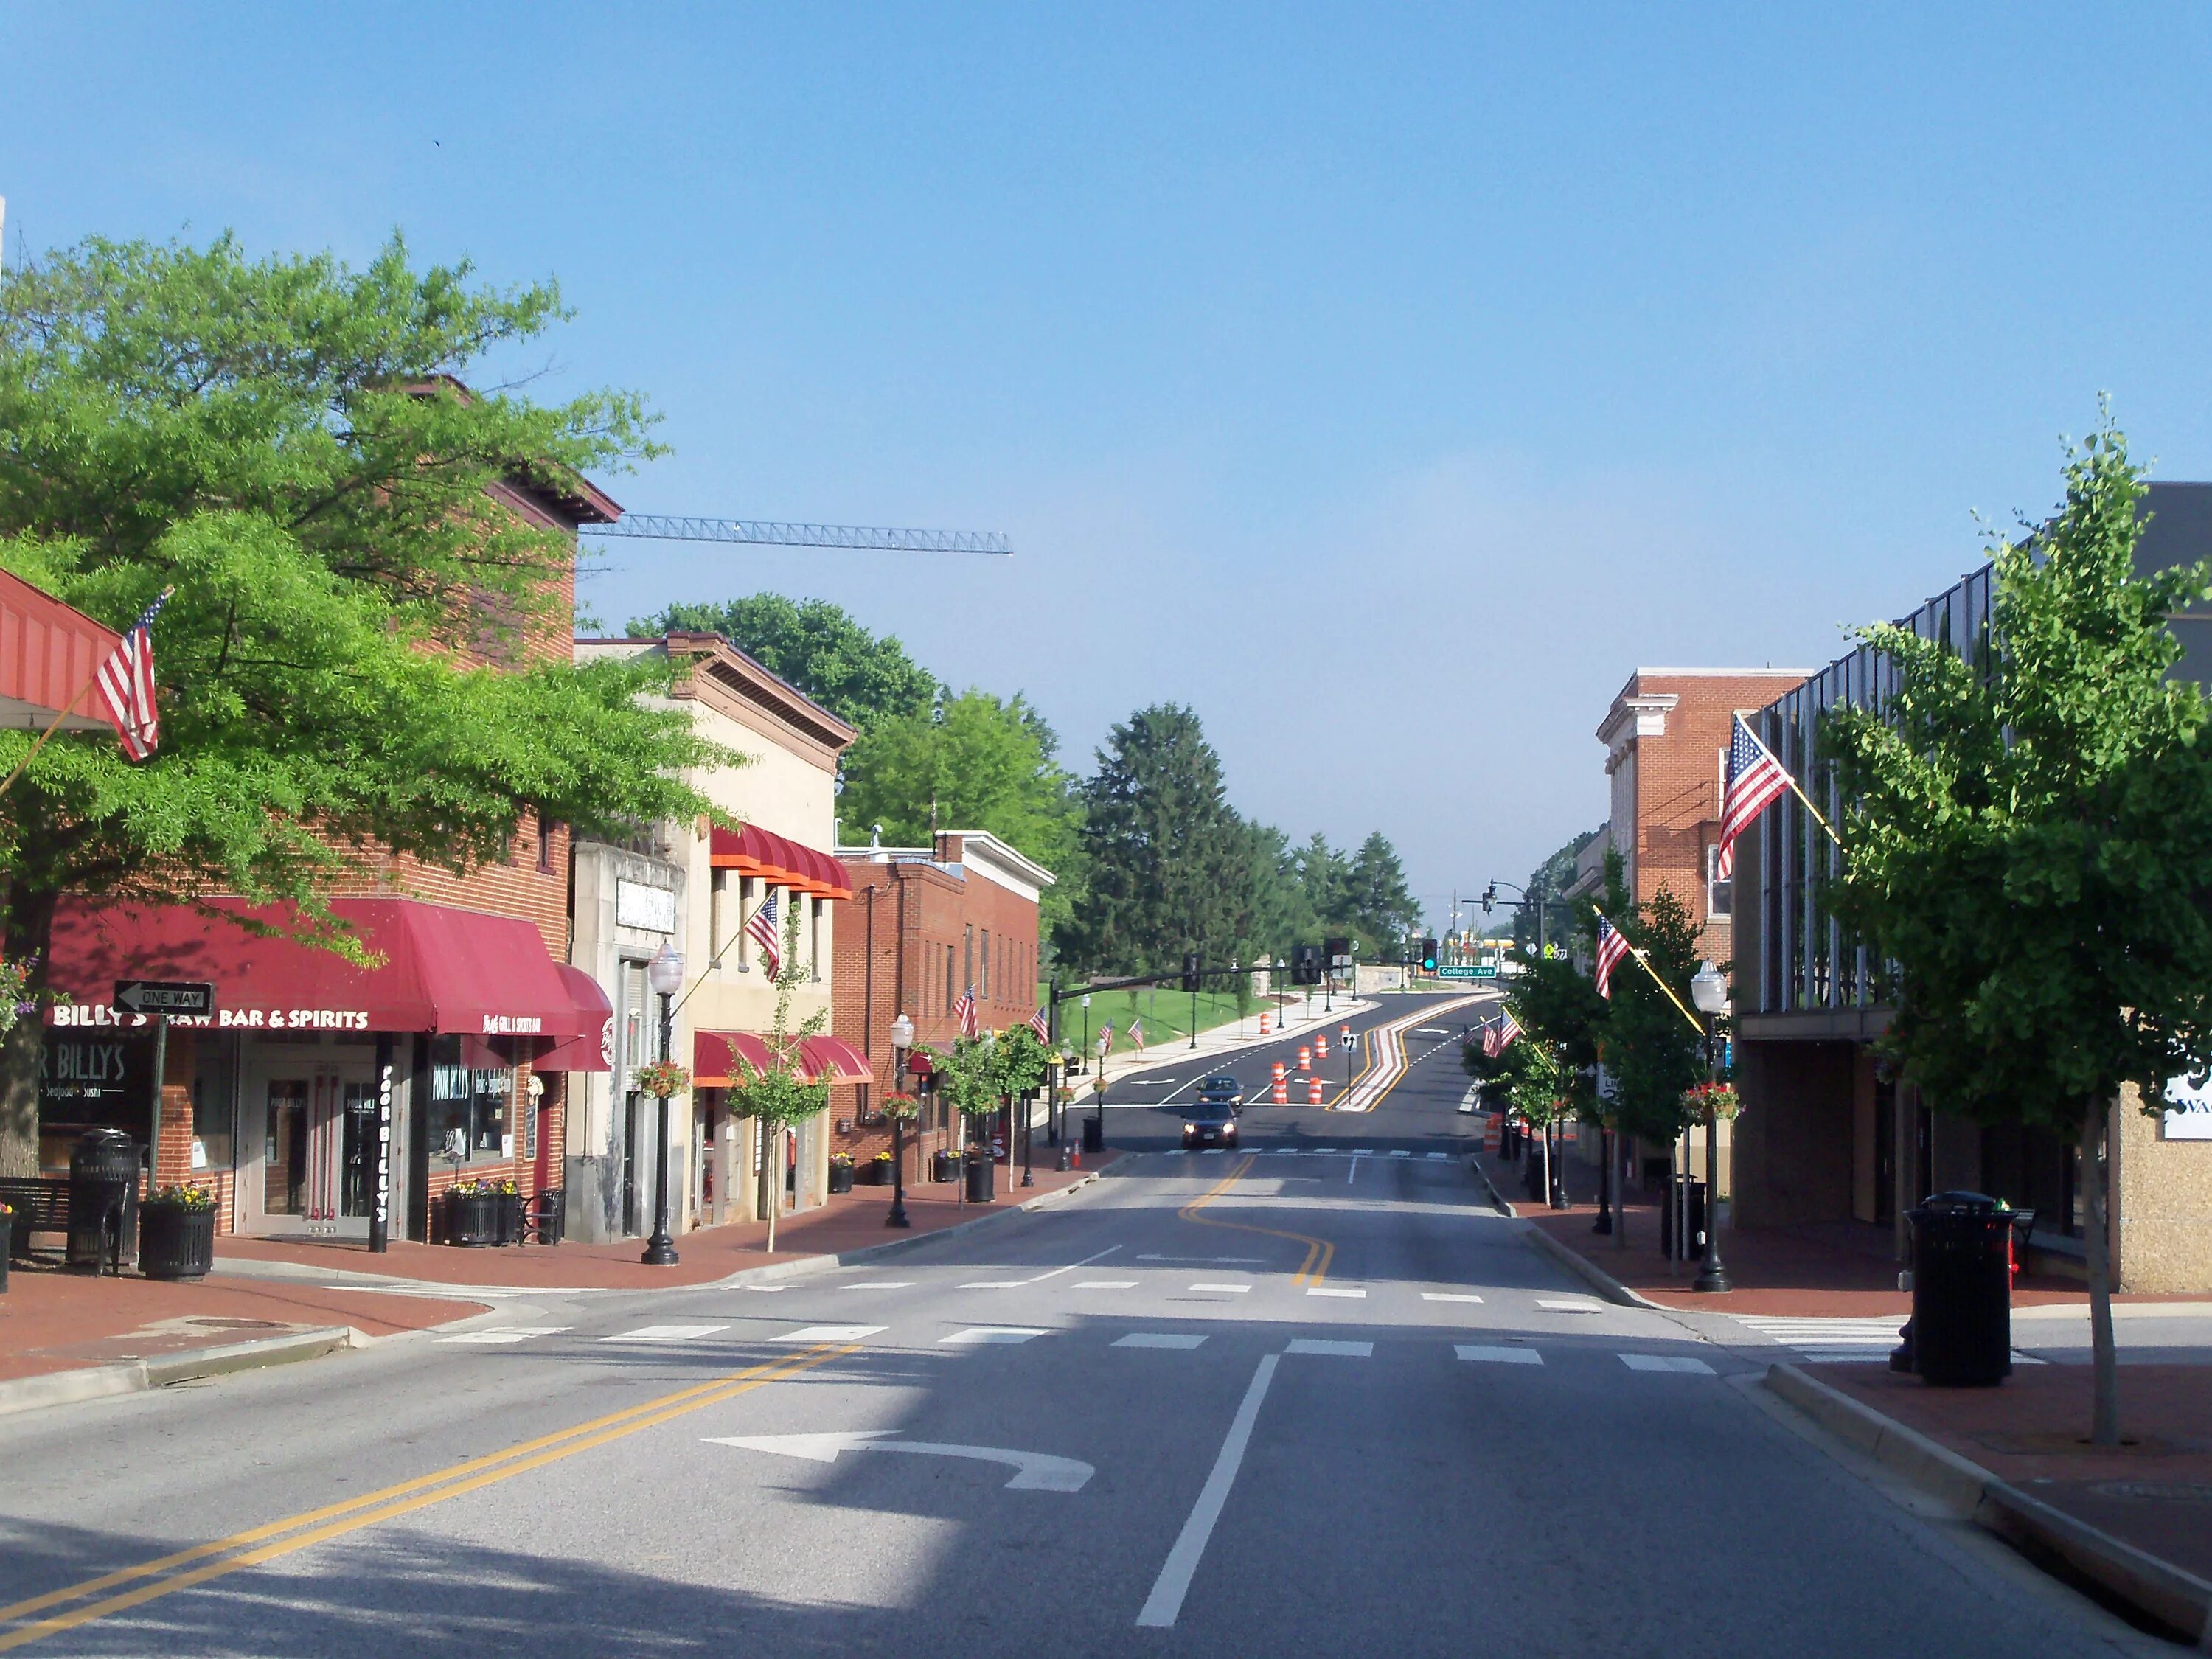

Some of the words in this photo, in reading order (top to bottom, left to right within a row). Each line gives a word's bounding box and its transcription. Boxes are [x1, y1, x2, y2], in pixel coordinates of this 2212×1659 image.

[1441, 968, 1474, 976] College
[142, 991, 168, 1005] ONE
[173, 992, 201, 1006] WAY
[219, 1009, 264, 1027] BAR
[268, 1010, 285, 1029] &
[288, 1009, 368, 1029] SPIRITS
[57, 1043, 125, 1081] BILLY'S
[380, 1065, 392, 1122] POOR
[375, 1126, 390, 1222] BILLY'S
